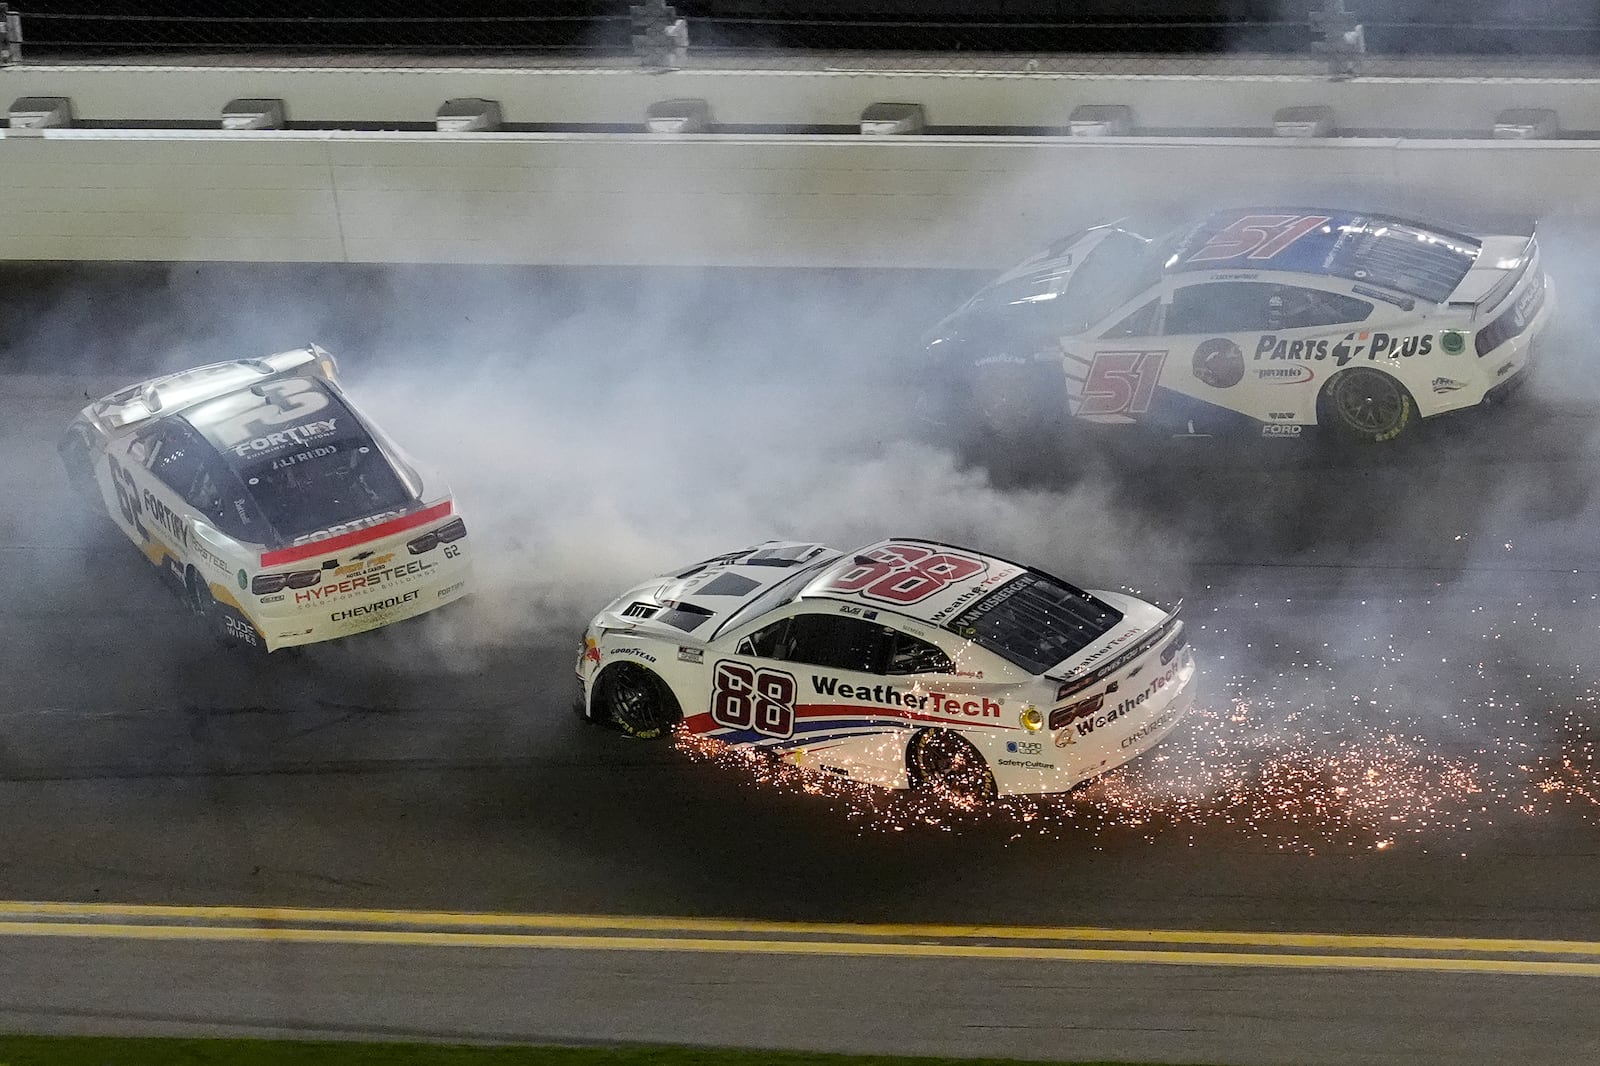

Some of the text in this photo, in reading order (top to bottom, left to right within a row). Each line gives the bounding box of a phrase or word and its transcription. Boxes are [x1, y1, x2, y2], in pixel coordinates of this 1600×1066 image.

[1187, 215, 1333, 263] 51
[1253, 333, 1434, 361] PARTS PLUS
[1075, 350, 1168, 417] 51
[235, 418, 337, 457] FORTIFY
[1263, 425, 1302, 435] FORD
[143, 488, 188, 548] FORTIFY
[443, 544, 461, 559] 62
[295, 559, 432, 603] HYPERSTEEL
[825, 545, 990, 606] 88
[331, 590, 420, 621] CHEVROLET
[955, 575, 1036, 628] VAN GISBERGEN
[224, 615, 254, 634] DUDE
[226, 626, 257, 647] WIPES
[610, 647, 657, 663] GOODYEAR
[710, 658, 797, 740] 88
[812, 675, 1000, 718] WeatherTech
[1076, 662, 1178, 737] WeatherTech
[998, 758, 1055, 769] SafetyCulture
